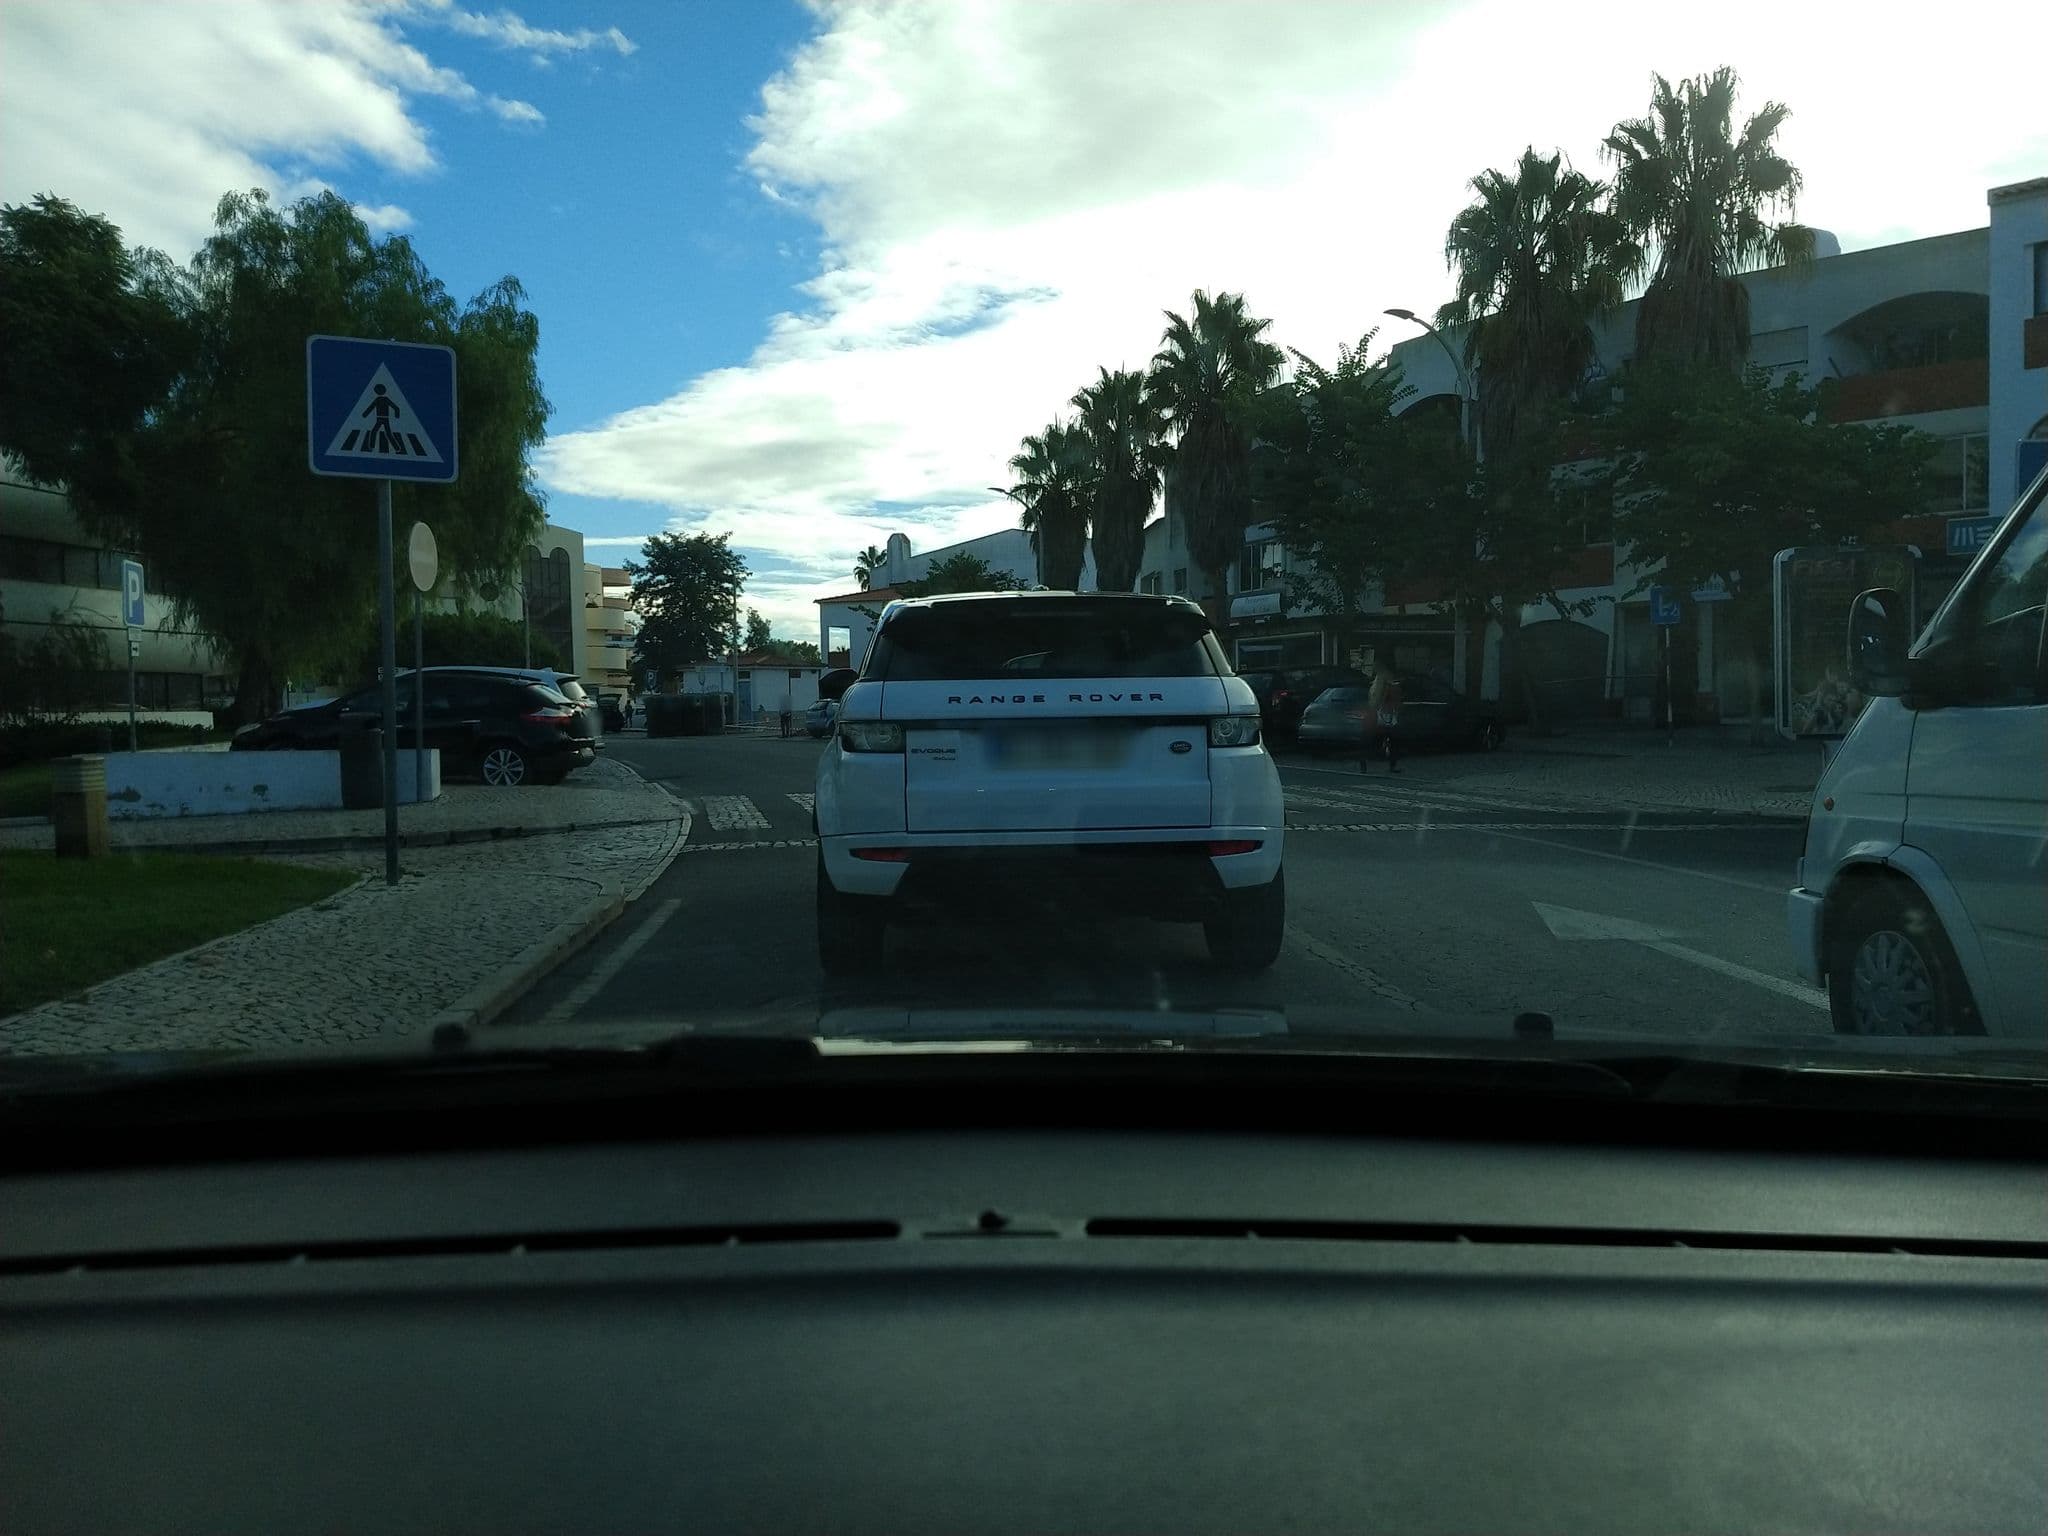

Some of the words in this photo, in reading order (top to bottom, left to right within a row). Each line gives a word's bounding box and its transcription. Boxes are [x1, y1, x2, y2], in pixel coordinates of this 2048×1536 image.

[1953, 525, 1994, 547] ME
[128, 570, 140, 618] P
[947, 694, 1047, 705] RANGE
[1068, 692, 1166, 703] ROVER
